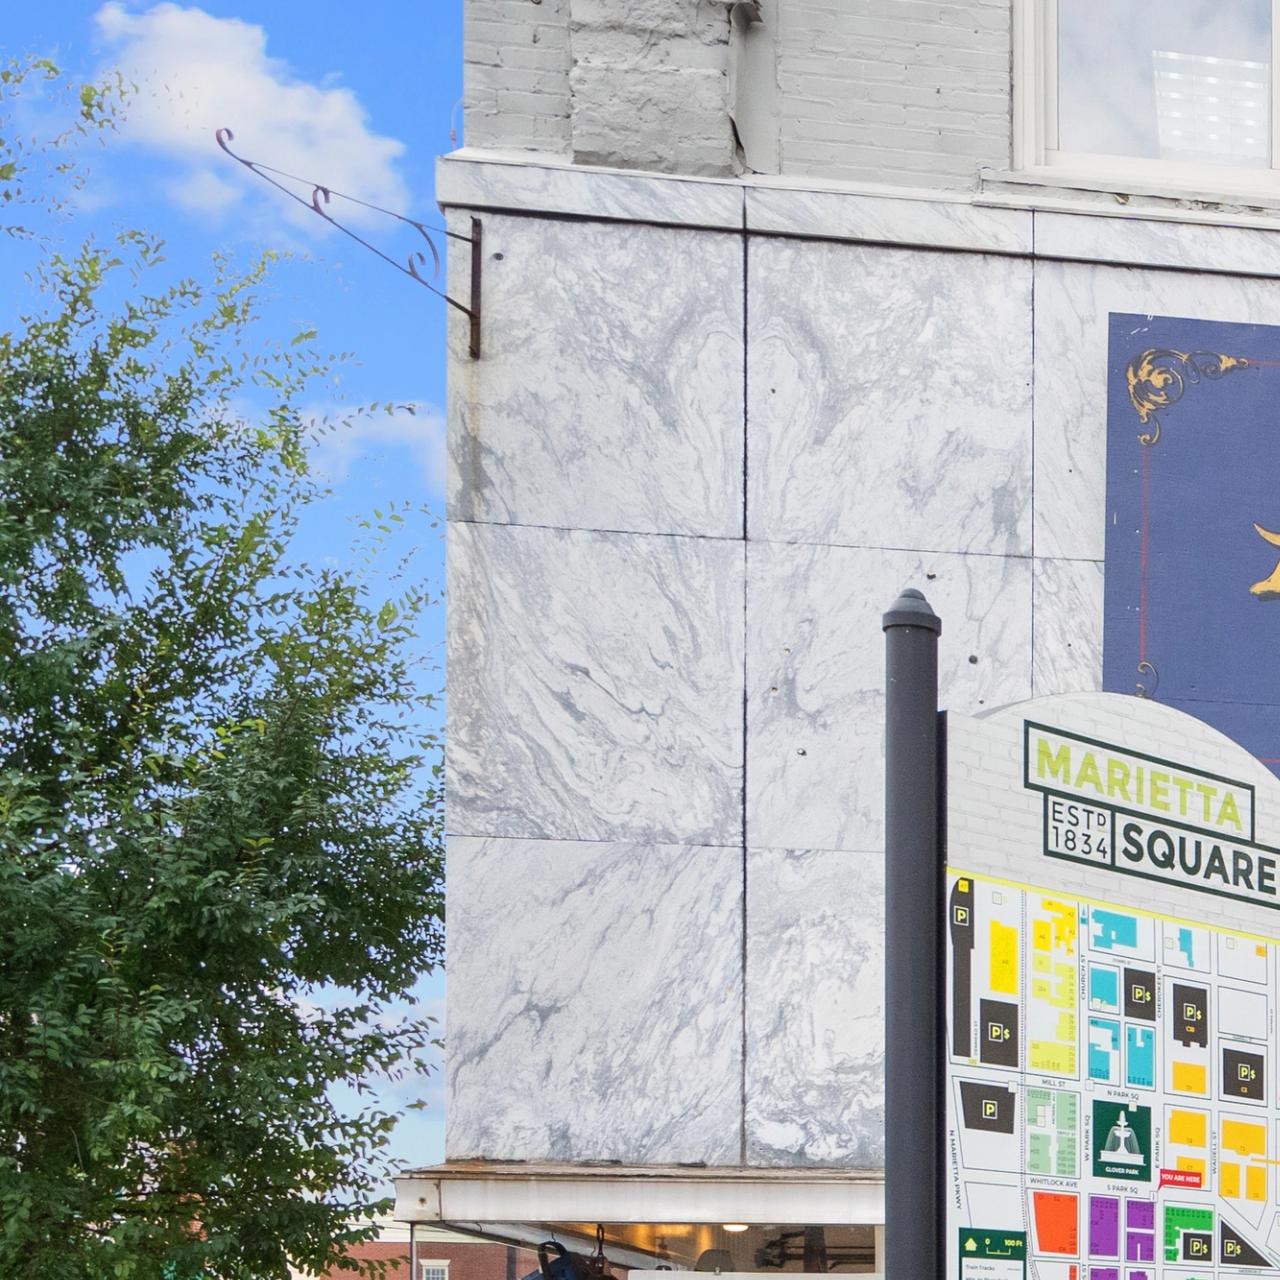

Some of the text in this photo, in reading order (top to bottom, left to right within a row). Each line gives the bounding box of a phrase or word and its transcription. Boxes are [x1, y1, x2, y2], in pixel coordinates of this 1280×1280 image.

[1036, 738, 1243, 832] MARIETTA
[1052, 825, 1108, 860] 1834
[1122, 822, 1277, 896] SQUARE
[1042, 1079, 1056, 1087] MILL
[951, 1138, 960, 1182] MARIETTA
[1105, 1166, 1125, 1174] GLOVER
[1030, 1177, 1064, 1187] WHITLOCK
[1161, 1173, 1201, 1183] YOU ARE HERE
[1112, 1185, 1128, 1193] PARK
[1004, 1239, 1015, 1247] 100
